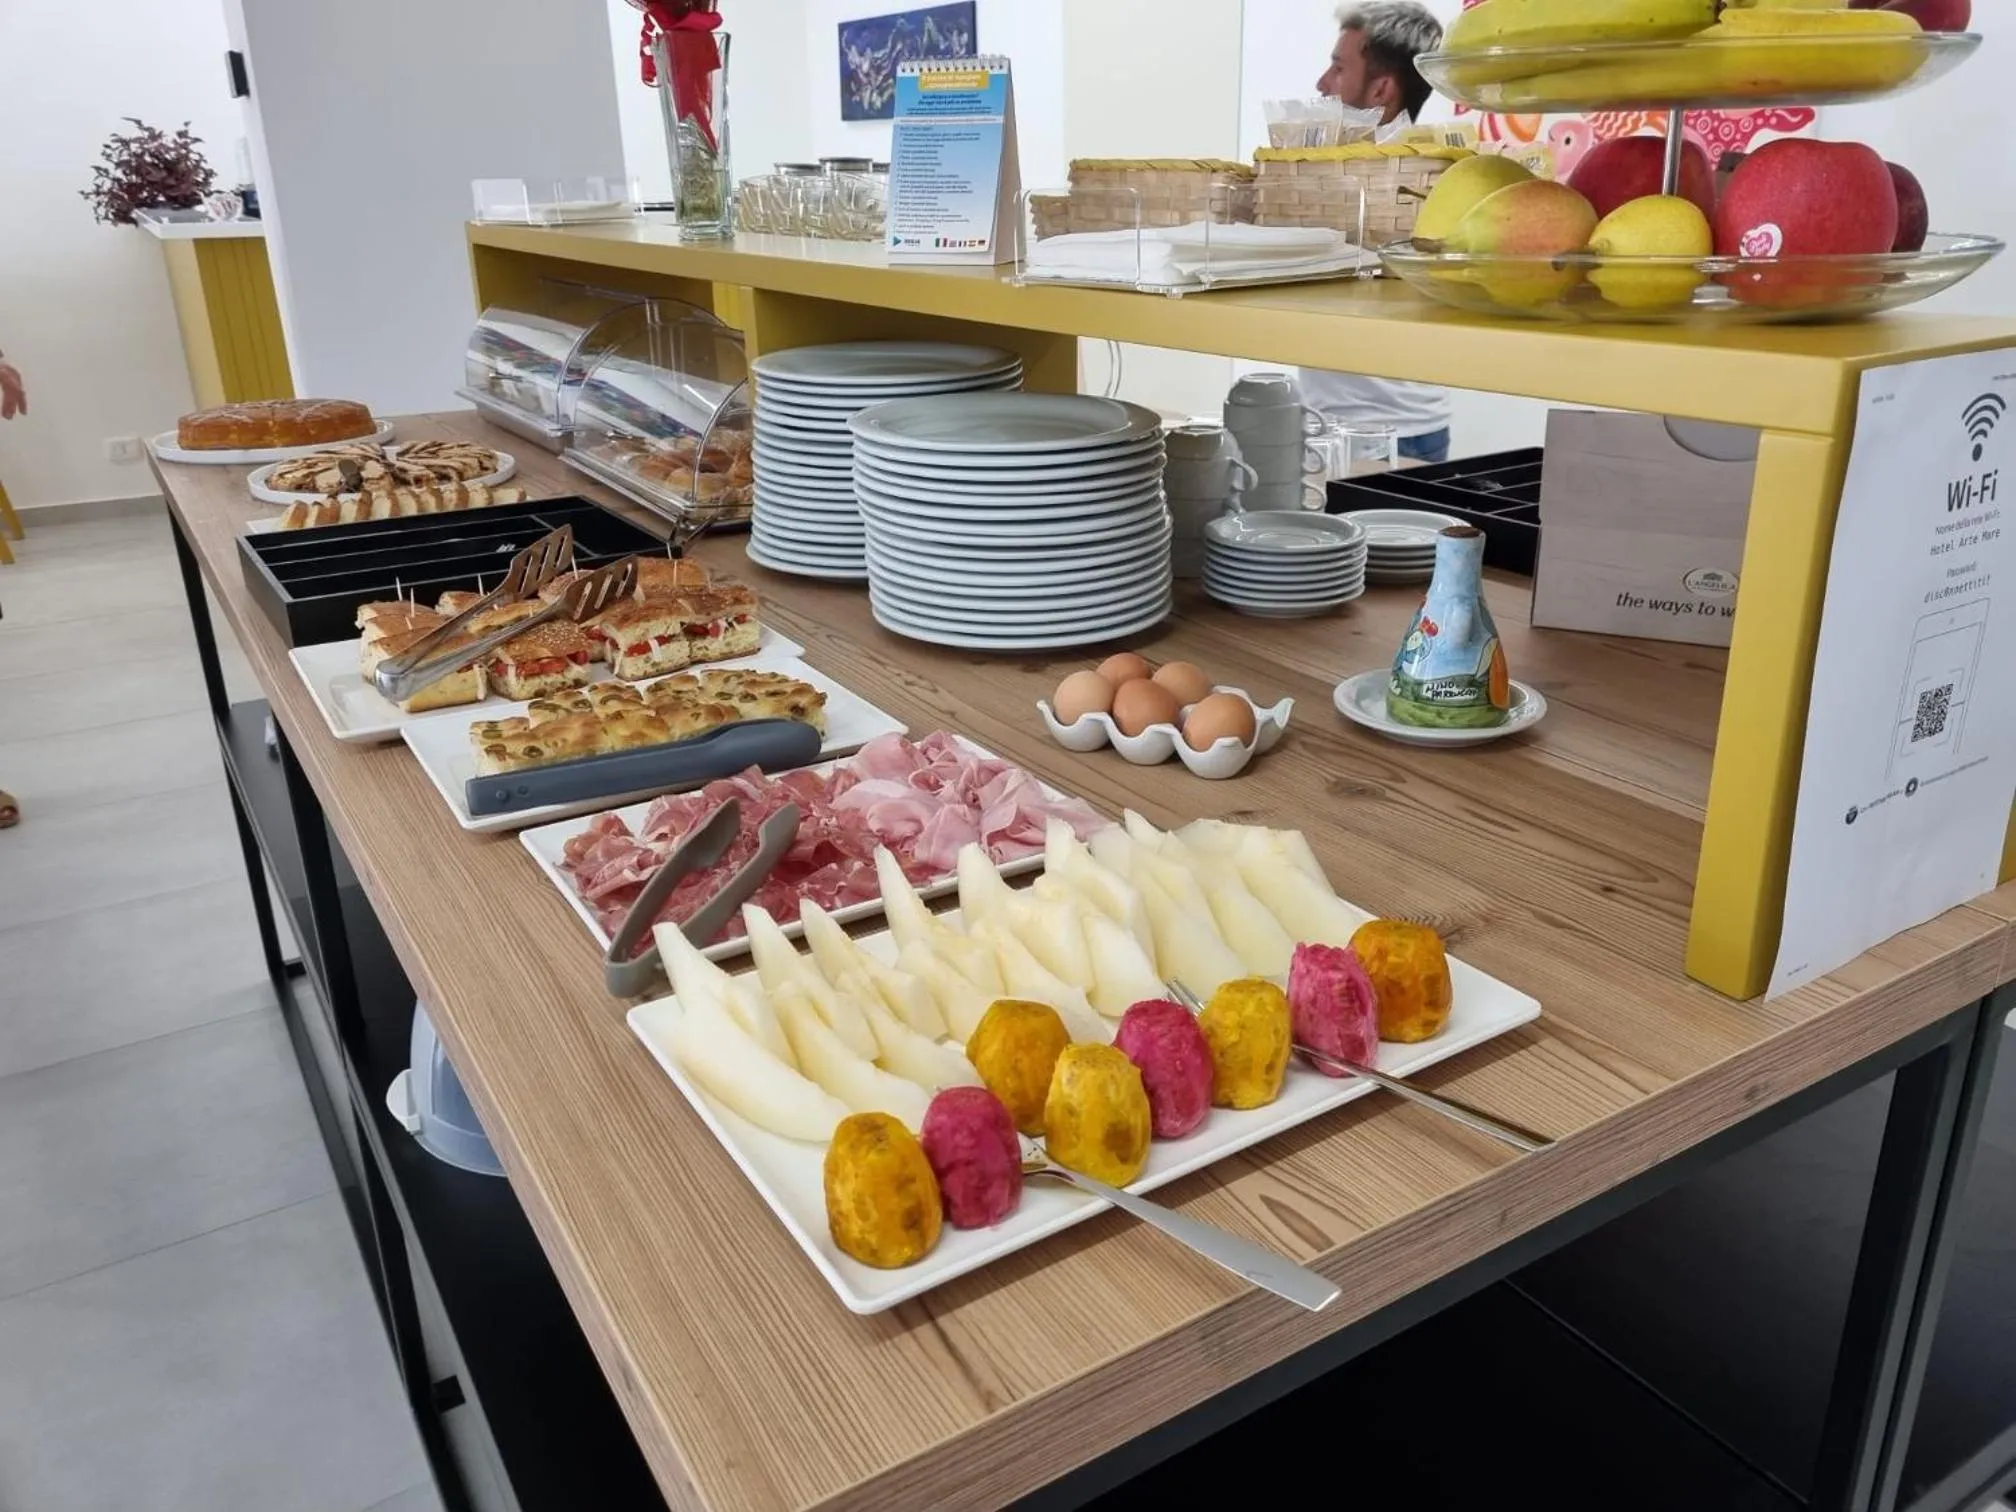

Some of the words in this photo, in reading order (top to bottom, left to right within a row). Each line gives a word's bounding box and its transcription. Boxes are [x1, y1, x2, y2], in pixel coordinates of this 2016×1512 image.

[1948, 469, 1999, 512] Wi-Fi
[1930, 539, 1954, 556] Hotel
[1959, 535, 1978, 547] Arte
[1981, 528, 2001, 541] Mare
[1616, 592, 1645, 608] the
[1648, 599, 1694, 616] ways
[1698, 602, 1716, 616] to
